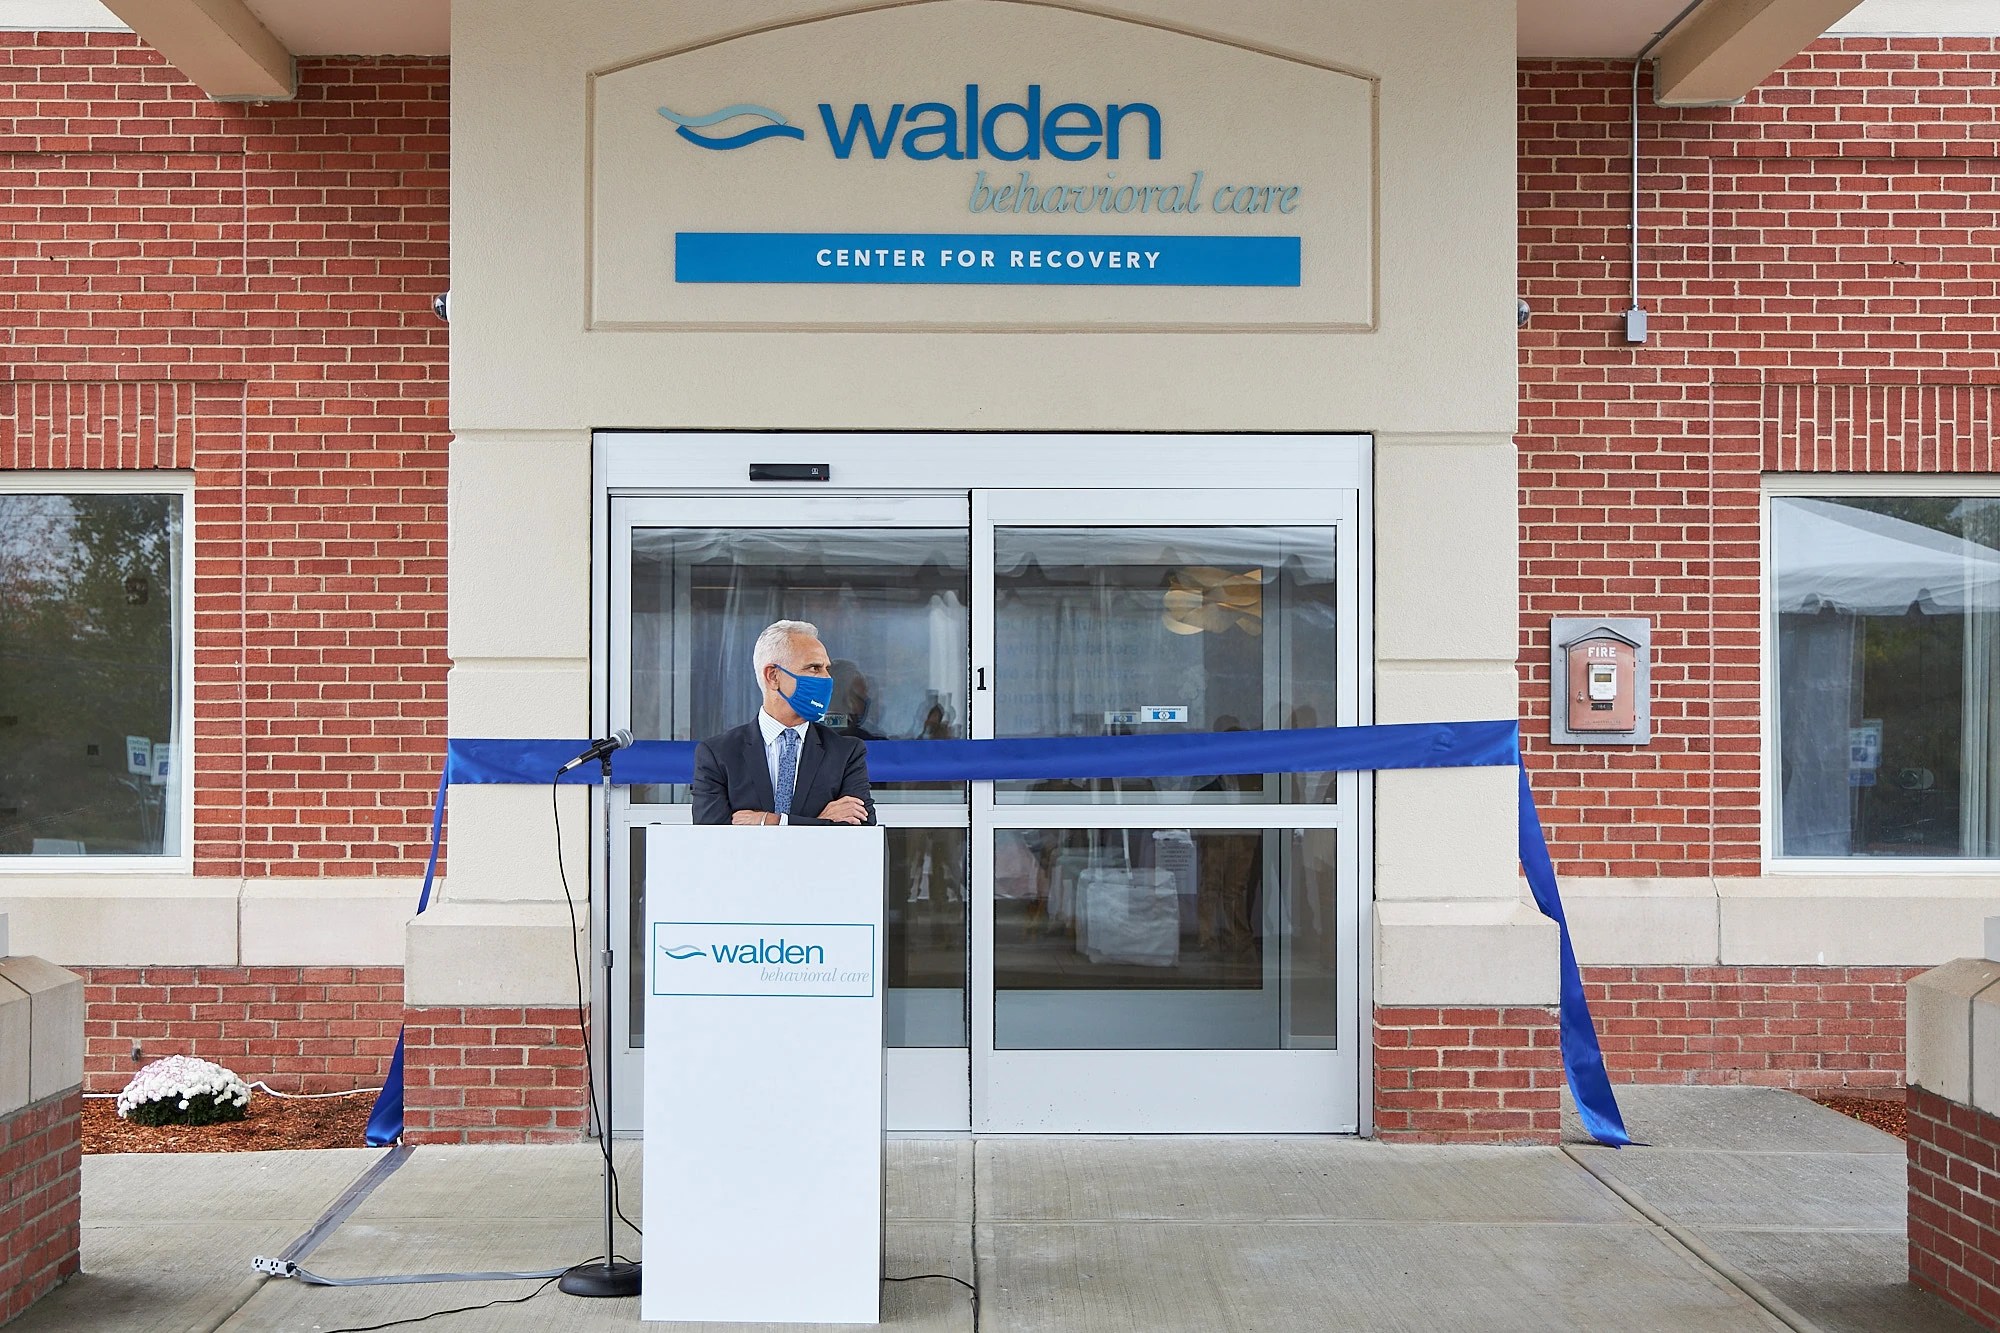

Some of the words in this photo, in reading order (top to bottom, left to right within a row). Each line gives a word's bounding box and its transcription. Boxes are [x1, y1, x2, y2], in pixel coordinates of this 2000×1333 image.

[819, 83, 1162, 161] walden
[969, 170, 1204, 214] behavioral
[1212, 182, 1302, 214] care
[816, 249, 925, 267] CENTER
[942, 249, 995, 268] FOR
[1011, 250, 1161, 269] RECOVERY
[1587, 646, 1617, 658] FIRE
[976, 667, 987, 691] 1
[711, 938, 824, 965] walden
[760, 967, 838, 983] behavioral
[839, 971, 870, 983] care
